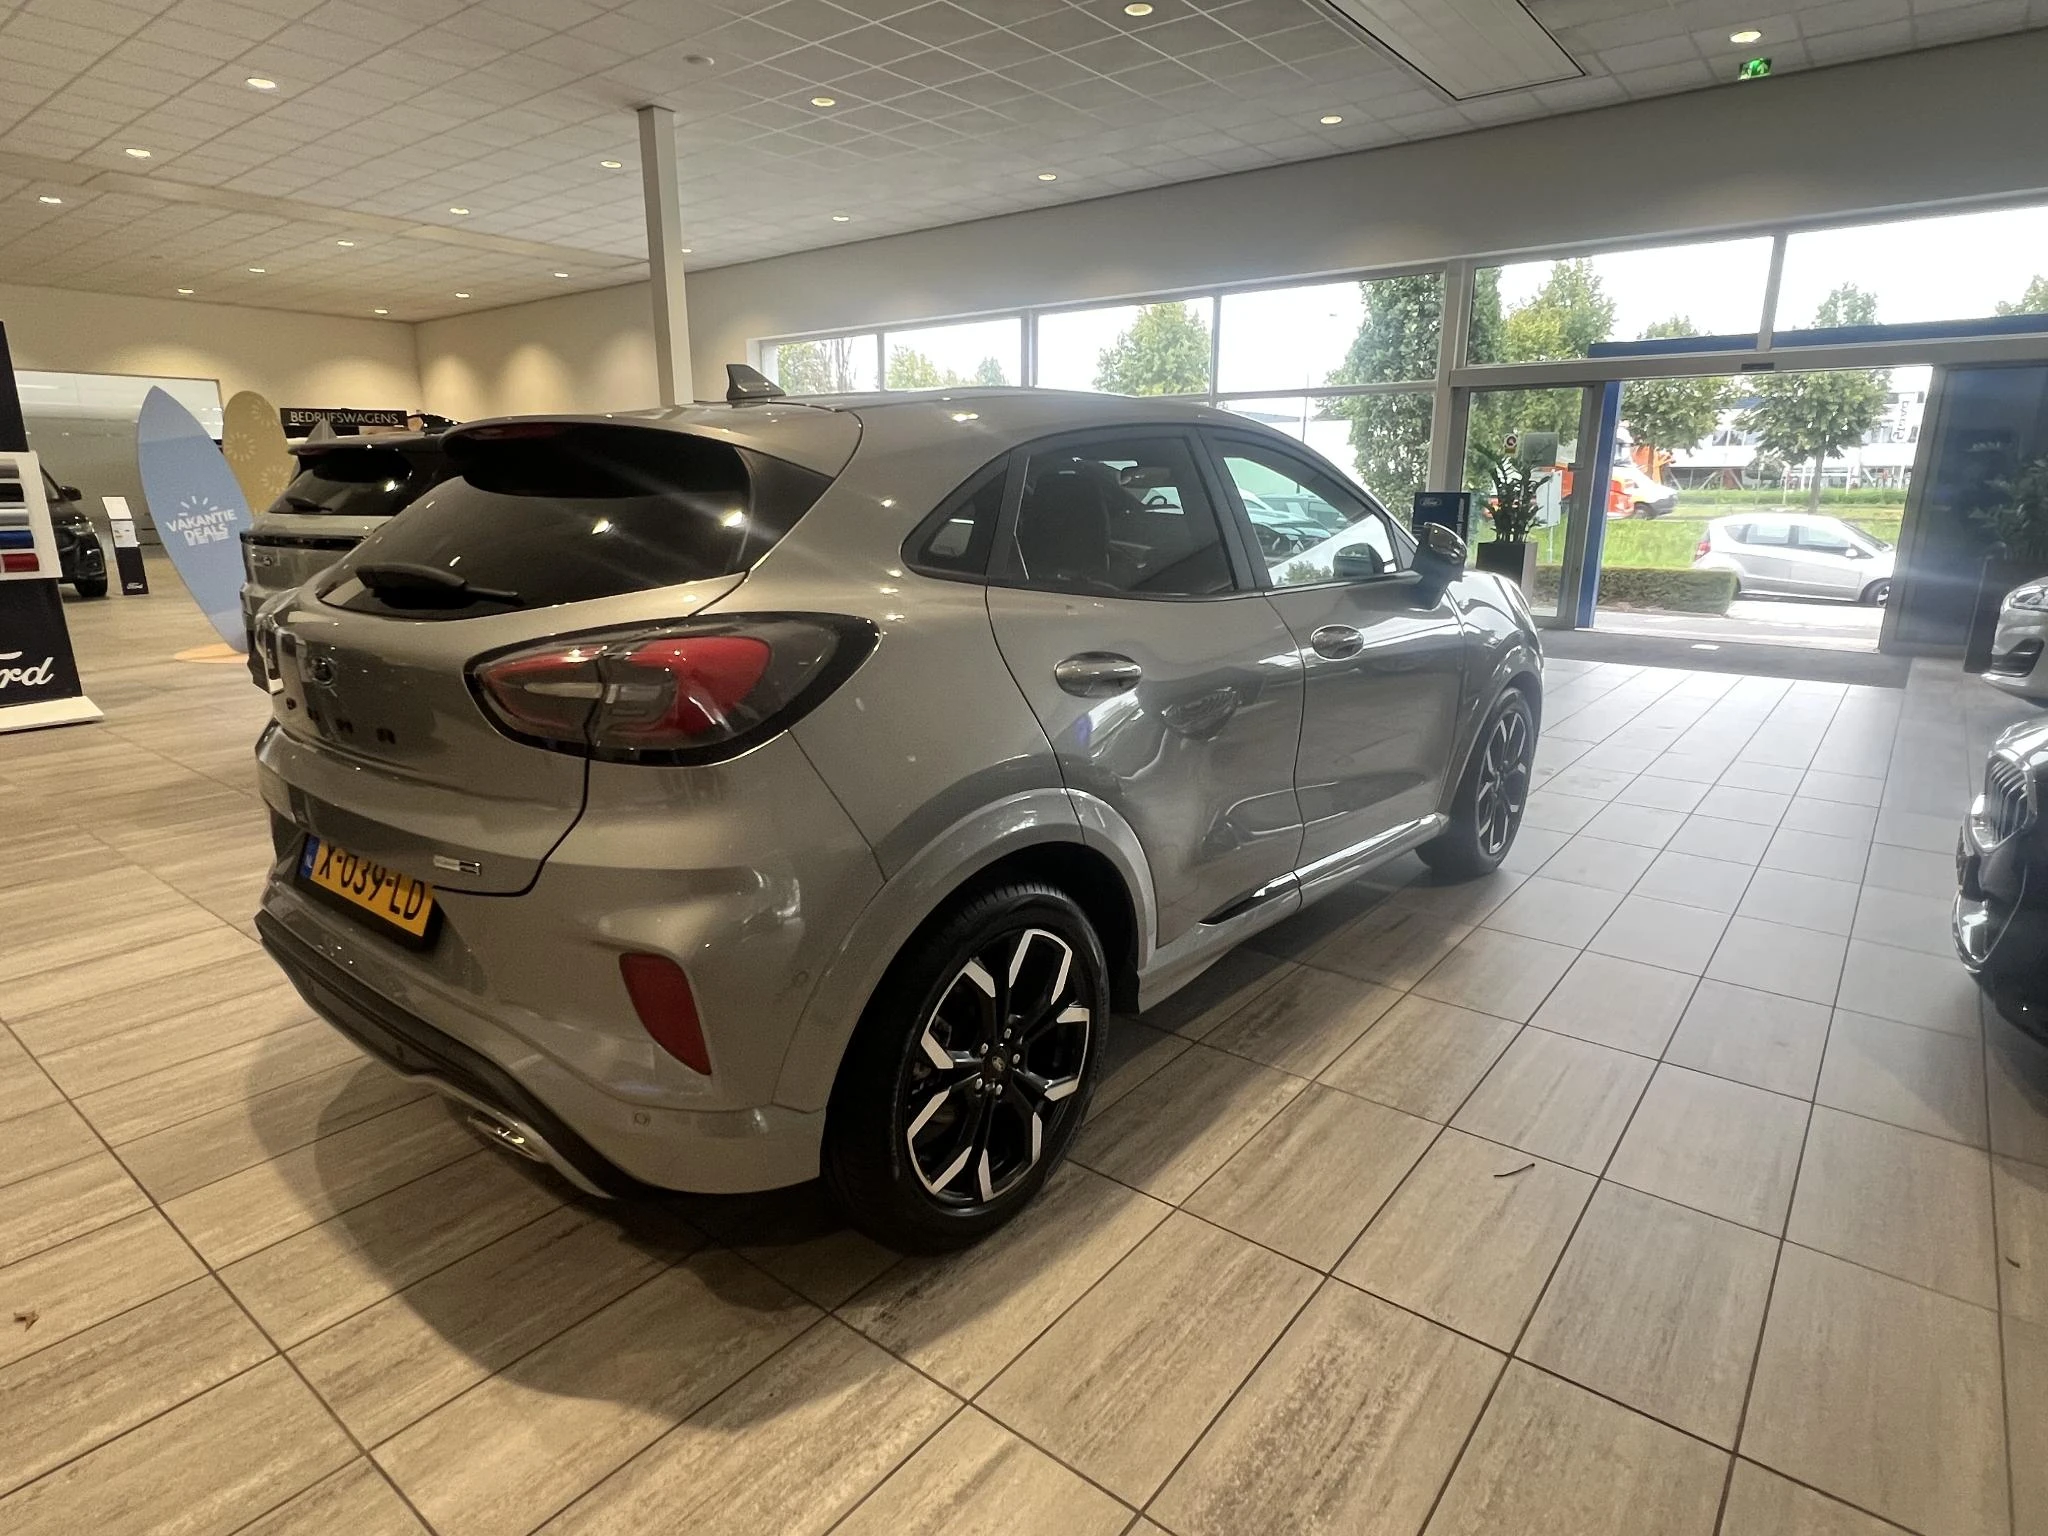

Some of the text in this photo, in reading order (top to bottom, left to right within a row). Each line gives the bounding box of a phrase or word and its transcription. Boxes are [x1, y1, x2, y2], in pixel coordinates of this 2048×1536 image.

[165, 508, 238, 532] VAKANTIE
[183, 523, 230, 546] DEALS
[0, 651, 55, 689] rd
[319, 842, 426, 921] X-039-LD
